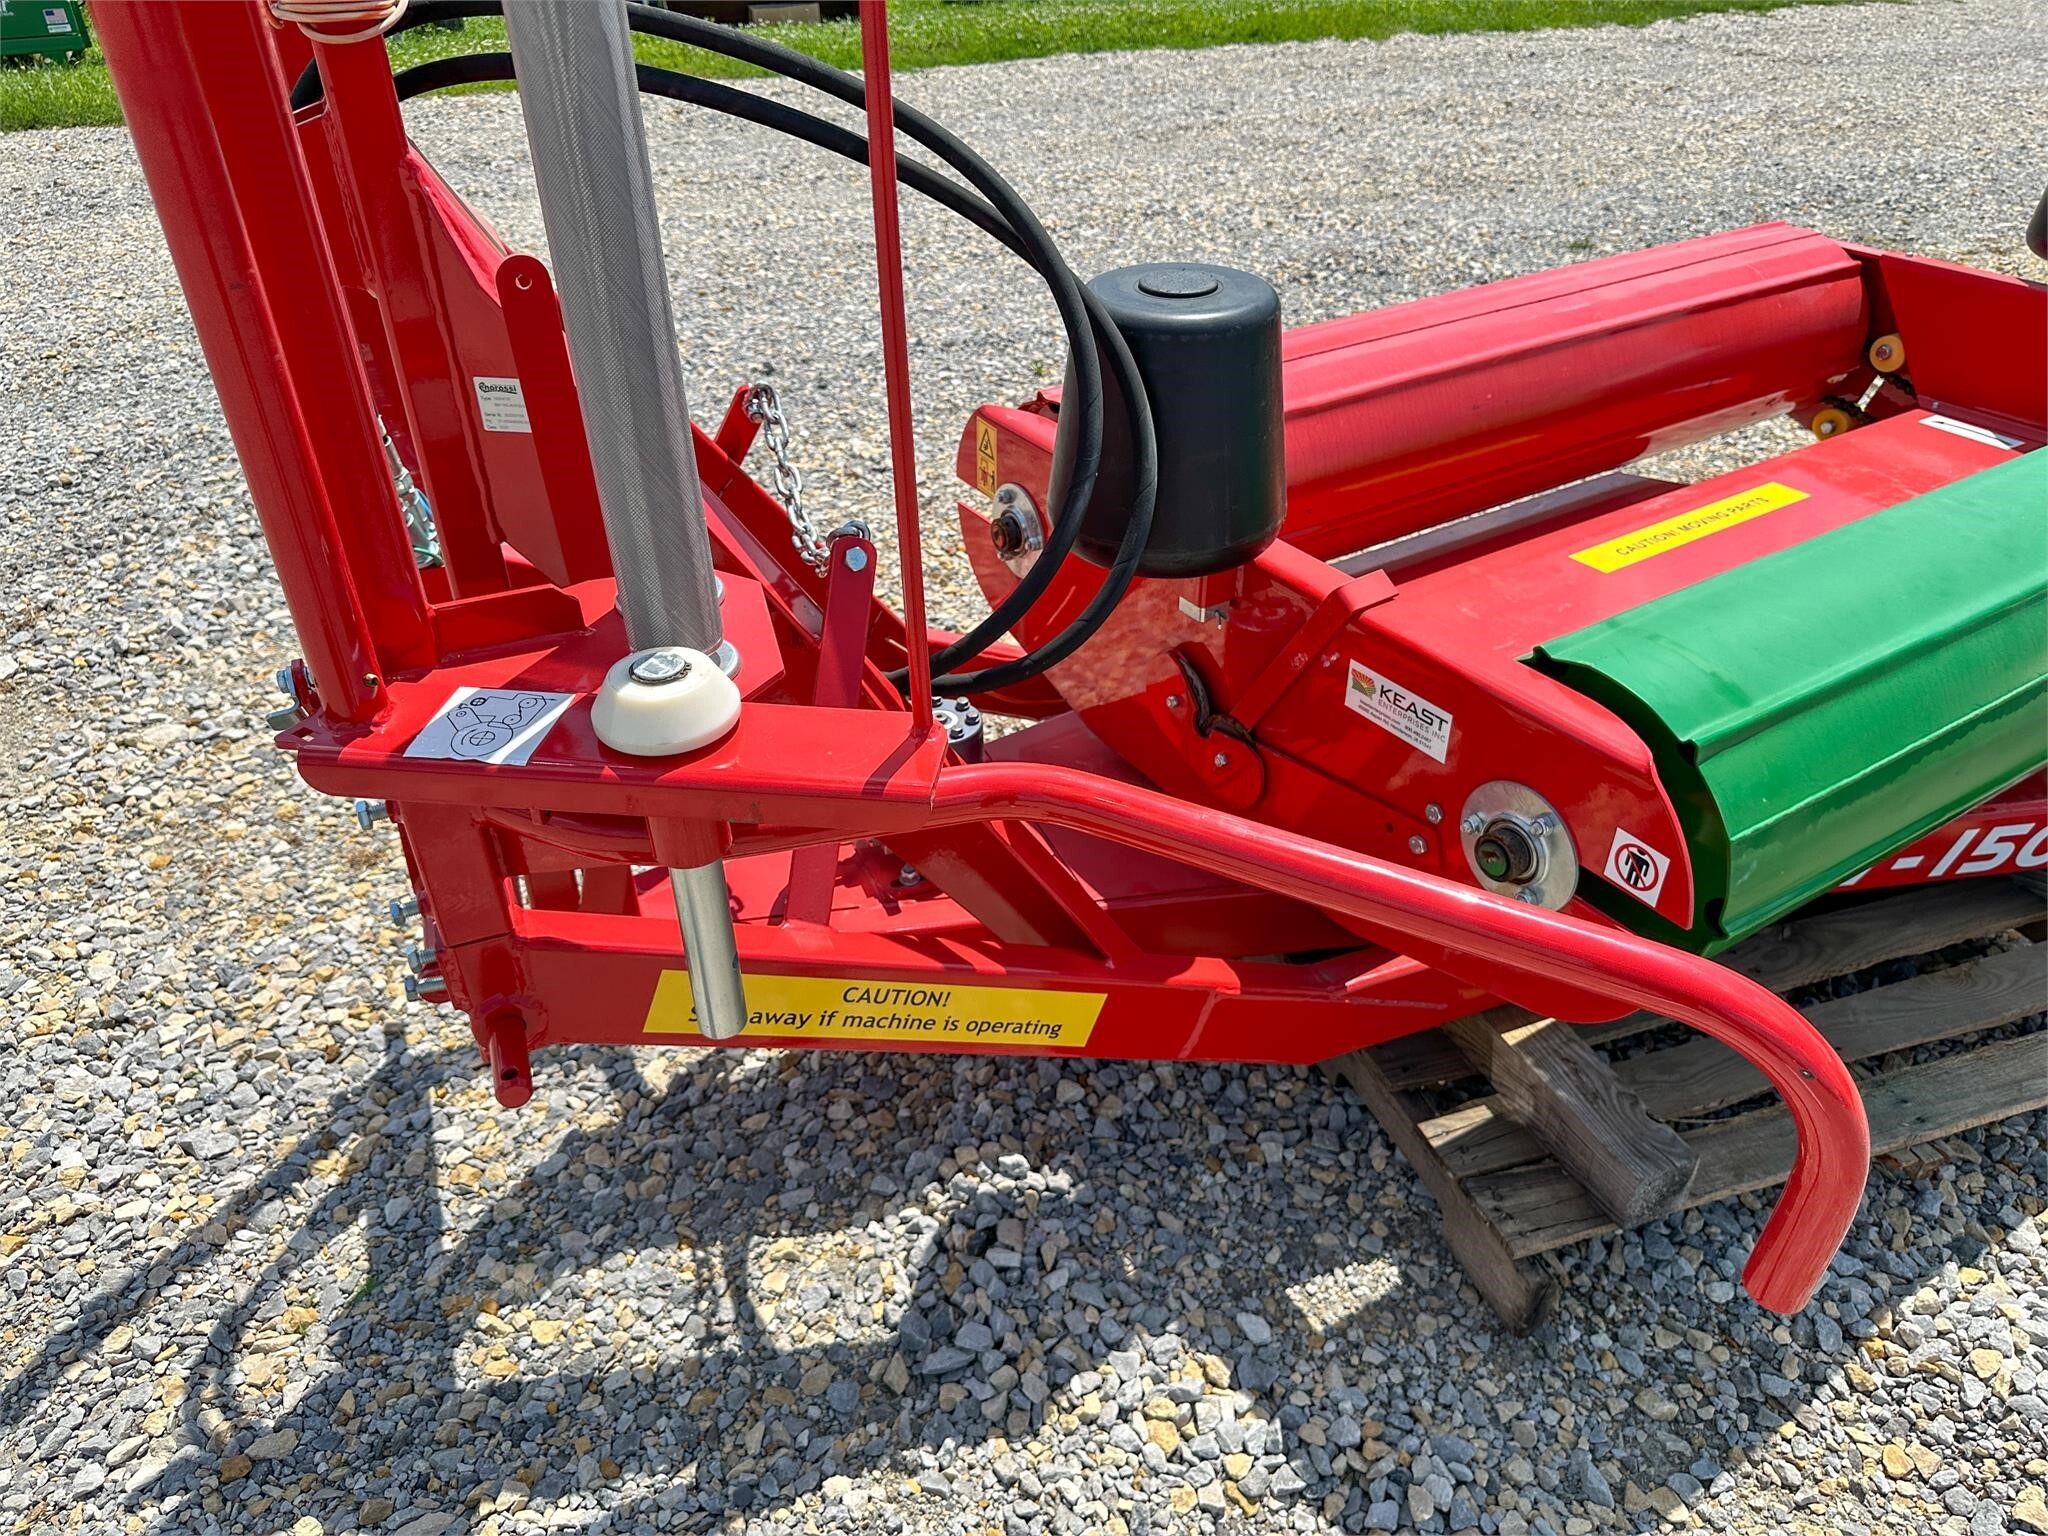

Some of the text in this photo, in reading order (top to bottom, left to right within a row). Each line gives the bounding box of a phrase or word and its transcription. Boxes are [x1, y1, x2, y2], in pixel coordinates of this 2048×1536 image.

[1616, 496, 1770, 556] CAUTION! MOVING PARTS
[1377, 699, 1446, 743] ENTERPRISES INC
[1379, 684, 1449, 732] KEAST
[842, 986, 951, 1008] CAUTION!
[749, 1010, 1063, 1039] away if machine is operating
